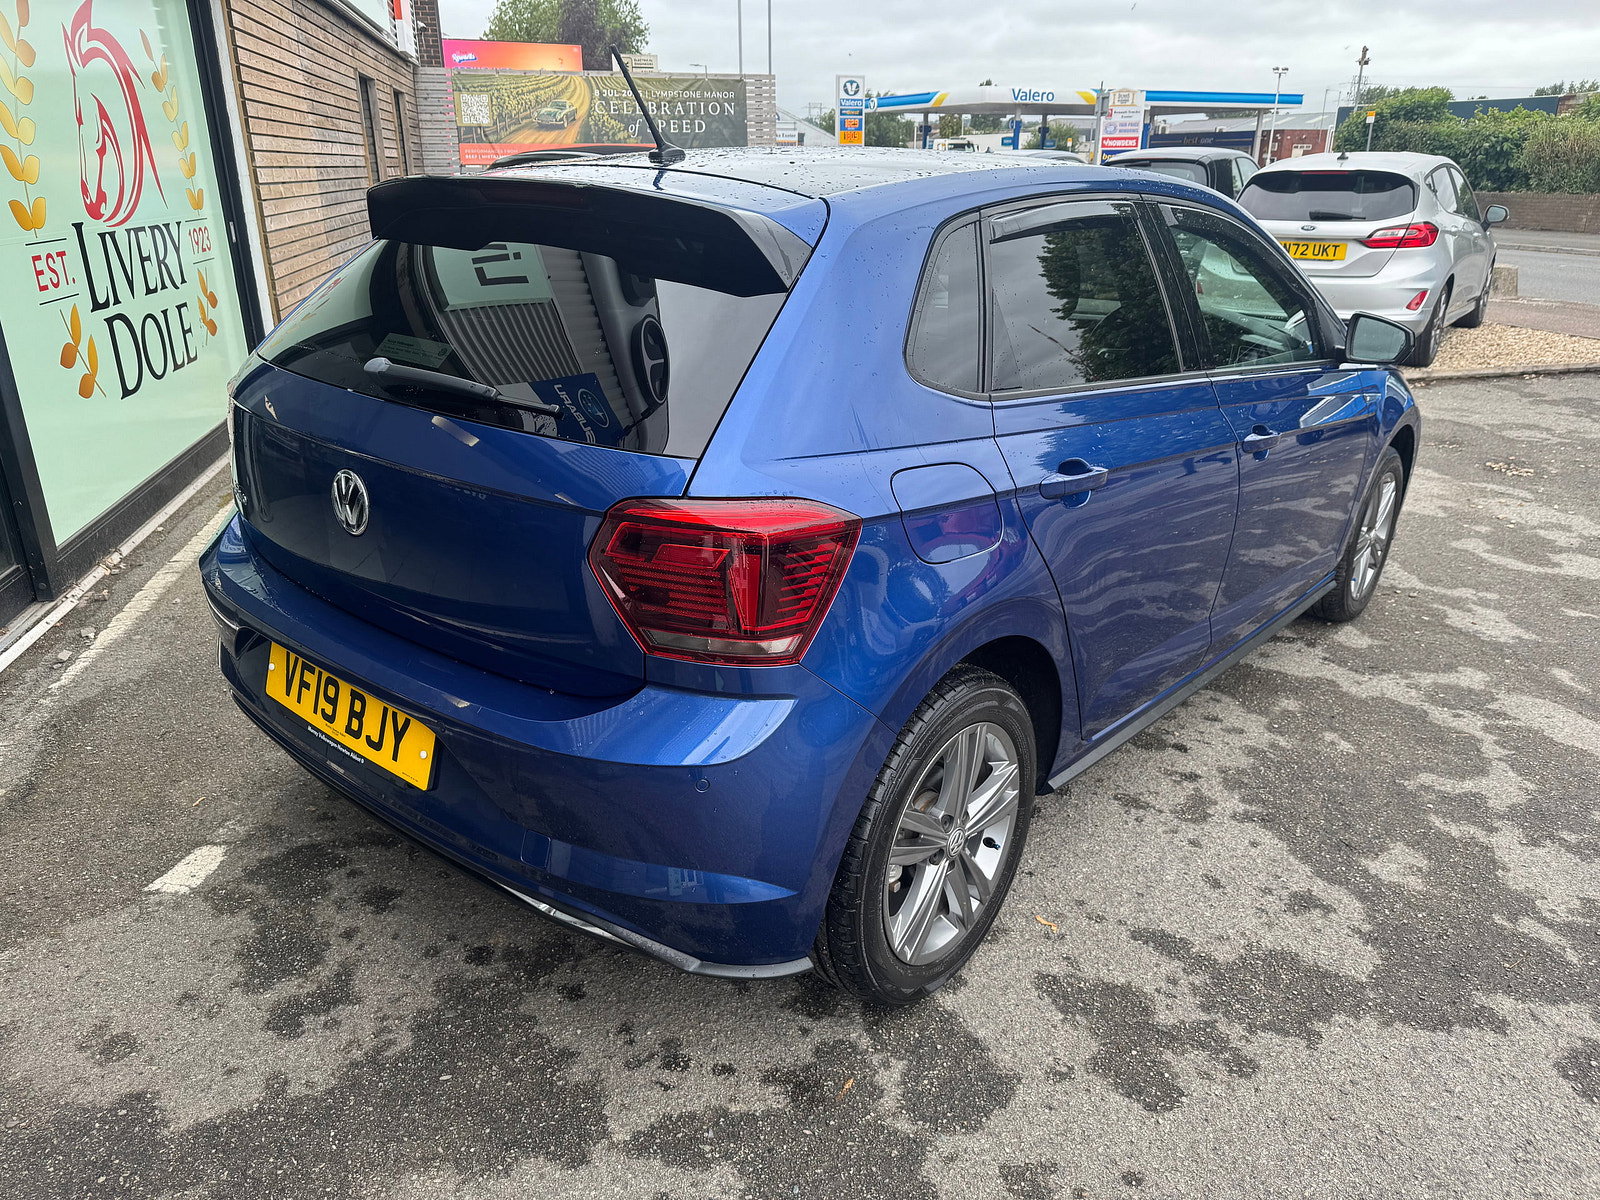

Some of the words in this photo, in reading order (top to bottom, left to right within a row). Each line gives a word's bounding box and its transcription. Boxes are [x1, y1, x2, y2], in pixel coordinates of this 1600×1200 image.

[651, 90, 701, 98] LYMPSTONE
[704, 91, 735, 99] MANOR
[1011, 88, 1055, 102] Valero
[595, 100, 736, 116] CELEBRATION
[628, 119, 643, 138] of
[646, 120, 706, 133] PEED
[188, 226, 212, 255] 1923
[1280, 242, 1309, 256] N72
[1312, 243, 1340, 258] UKT
[31, 250, 76, 292] EST.
[72, 221, 188, 313] LIVERY
[104, 302, 198, 400] DOLE
[285, 650, 340, 725] VF19
[344, 688, 411, 763] BJY
